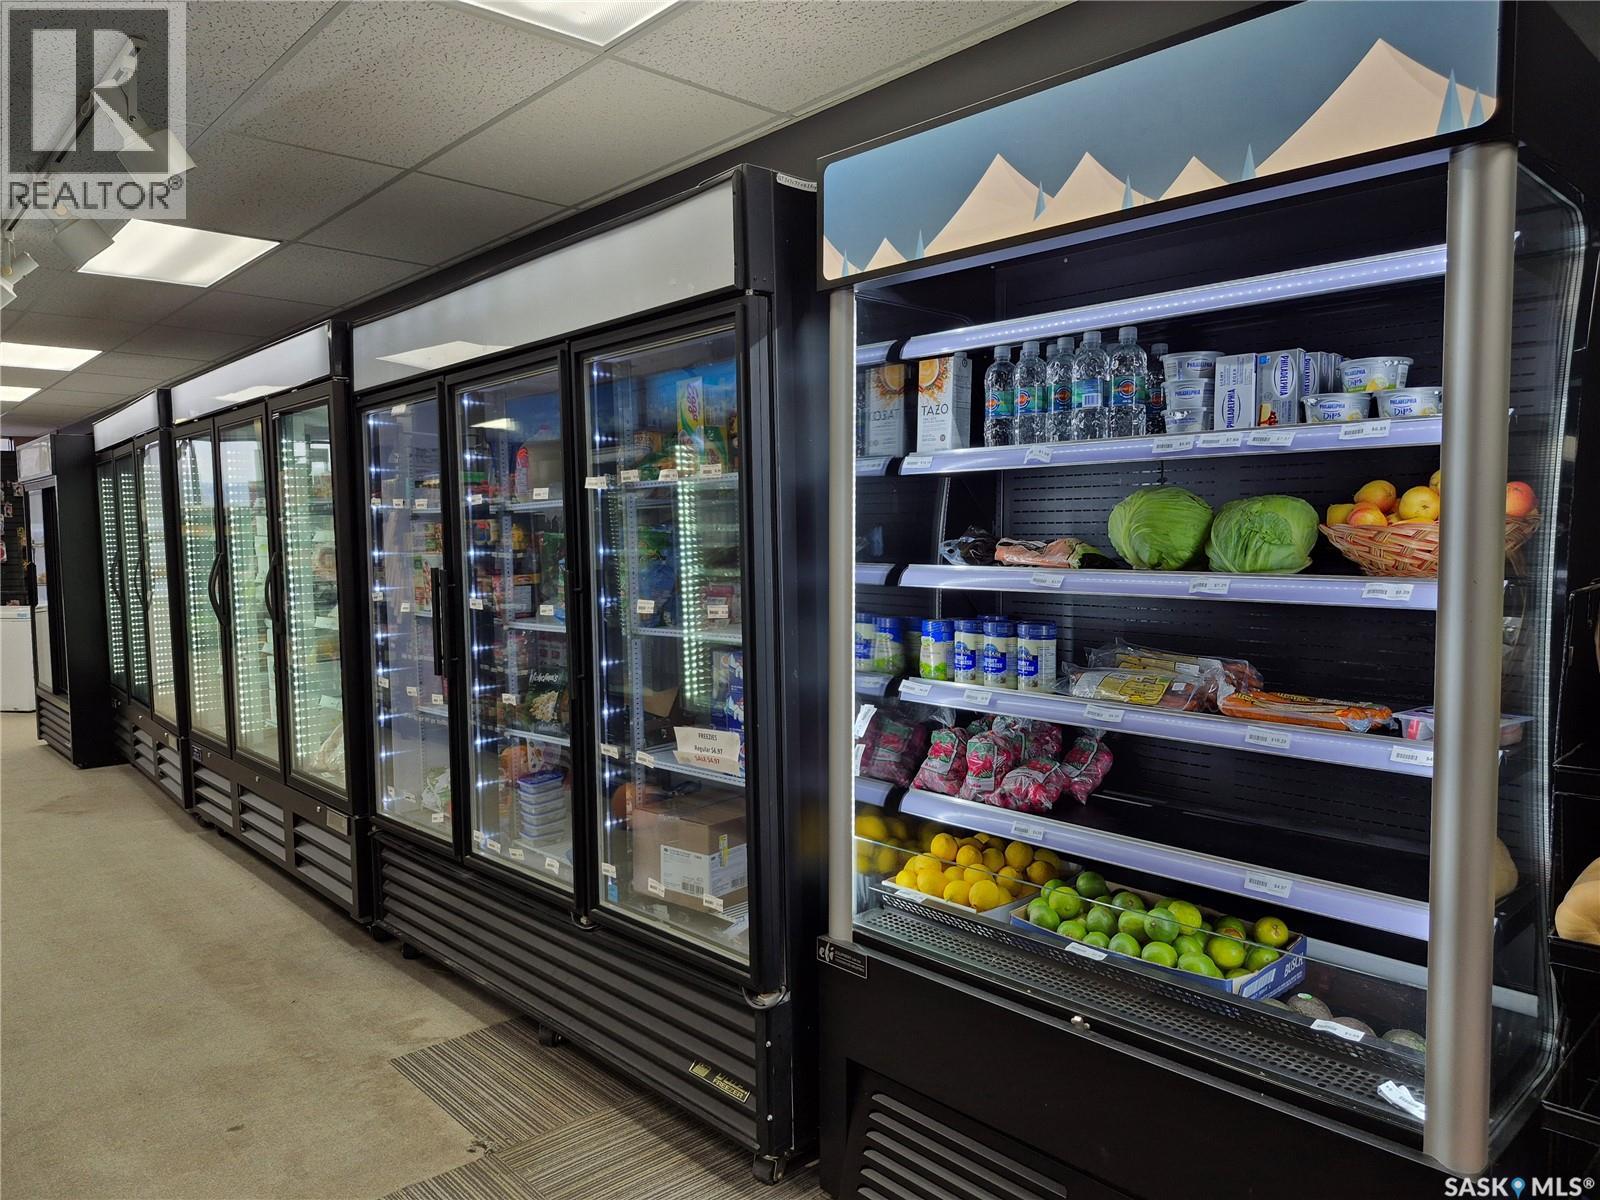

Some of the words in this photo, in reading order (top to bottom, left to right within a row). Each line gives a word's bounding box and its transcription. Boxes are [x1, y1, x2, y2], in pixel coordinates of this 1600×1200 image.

[1280, 355, 1289, 396] PHILADELPHIA
[1344, 368, 1366, 376] PHILADELPHIA
[1174, 389, 1201, 397] PHILADELPHIA
[921, 403, 949, 416] TAZO
[1226, 388, 1236, 429] PHILADELPHIA
[1319, 402, 1346, 410] PHILADELPHIA
[1393, 407, 1413, 416] Dips
[1322, 412, 1342, 420] Dips
[698, 732, 718, 741] FREEZIES
[694, 745, 711, 753] Regular
